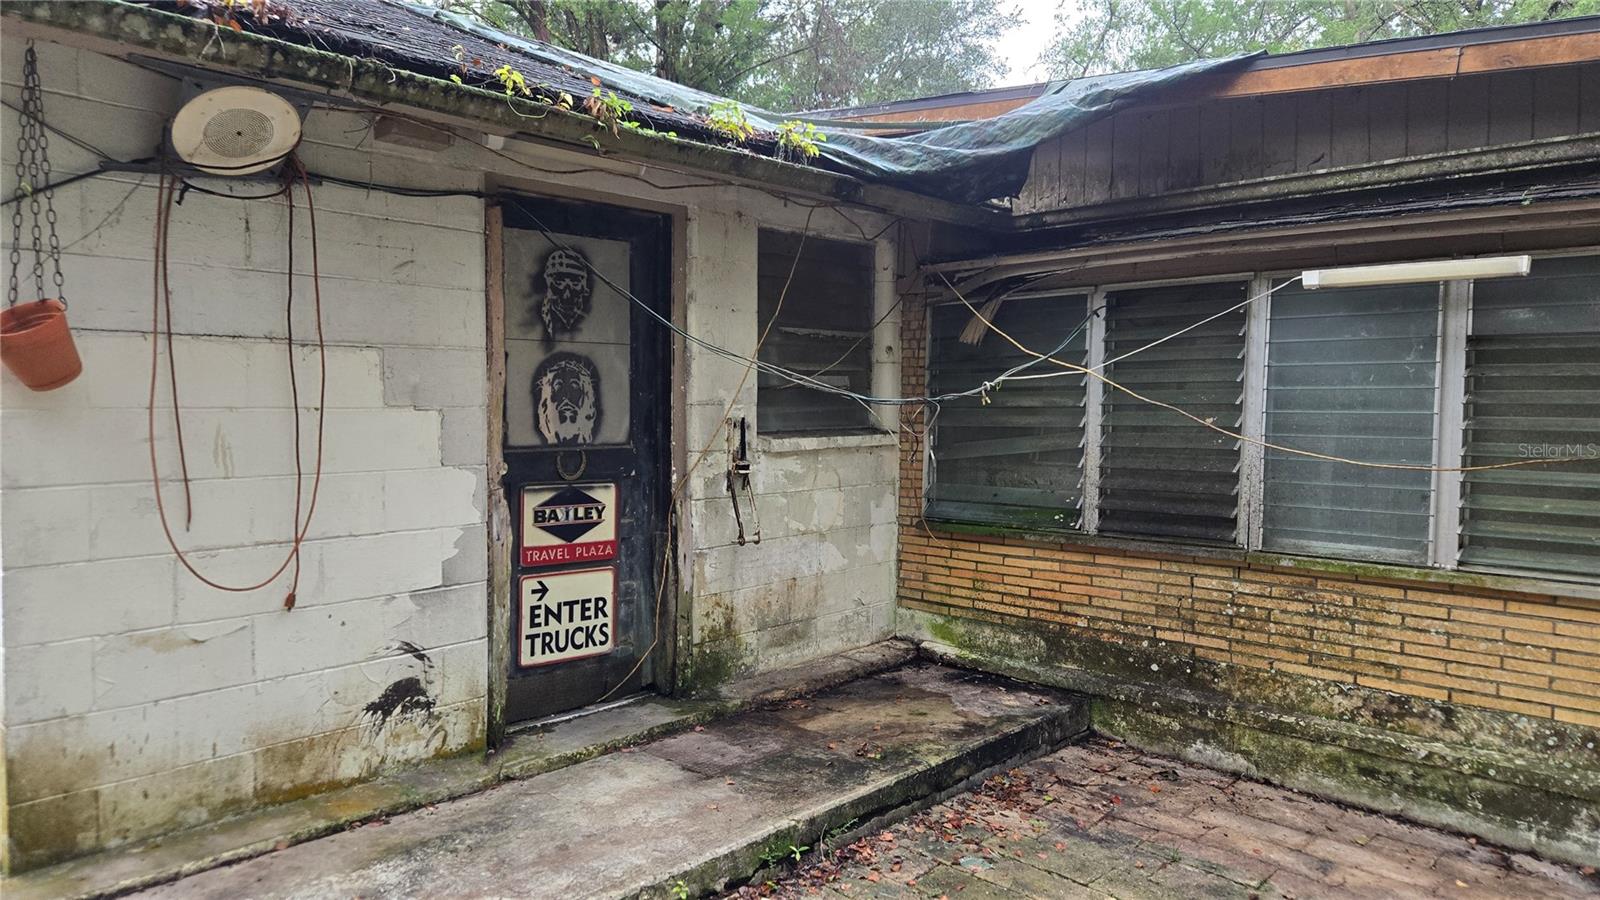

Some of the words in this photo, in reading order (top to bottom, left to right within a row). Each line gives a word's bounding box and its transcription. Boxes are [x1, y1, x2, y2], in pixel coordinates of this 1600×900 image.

[526, 549, 570, 562] TRAVEL
[575, 544, 613, 558] PLAZA
[529, 597, 609, 629] ENTER
[525, 623, 609, 657] TRUCKS
